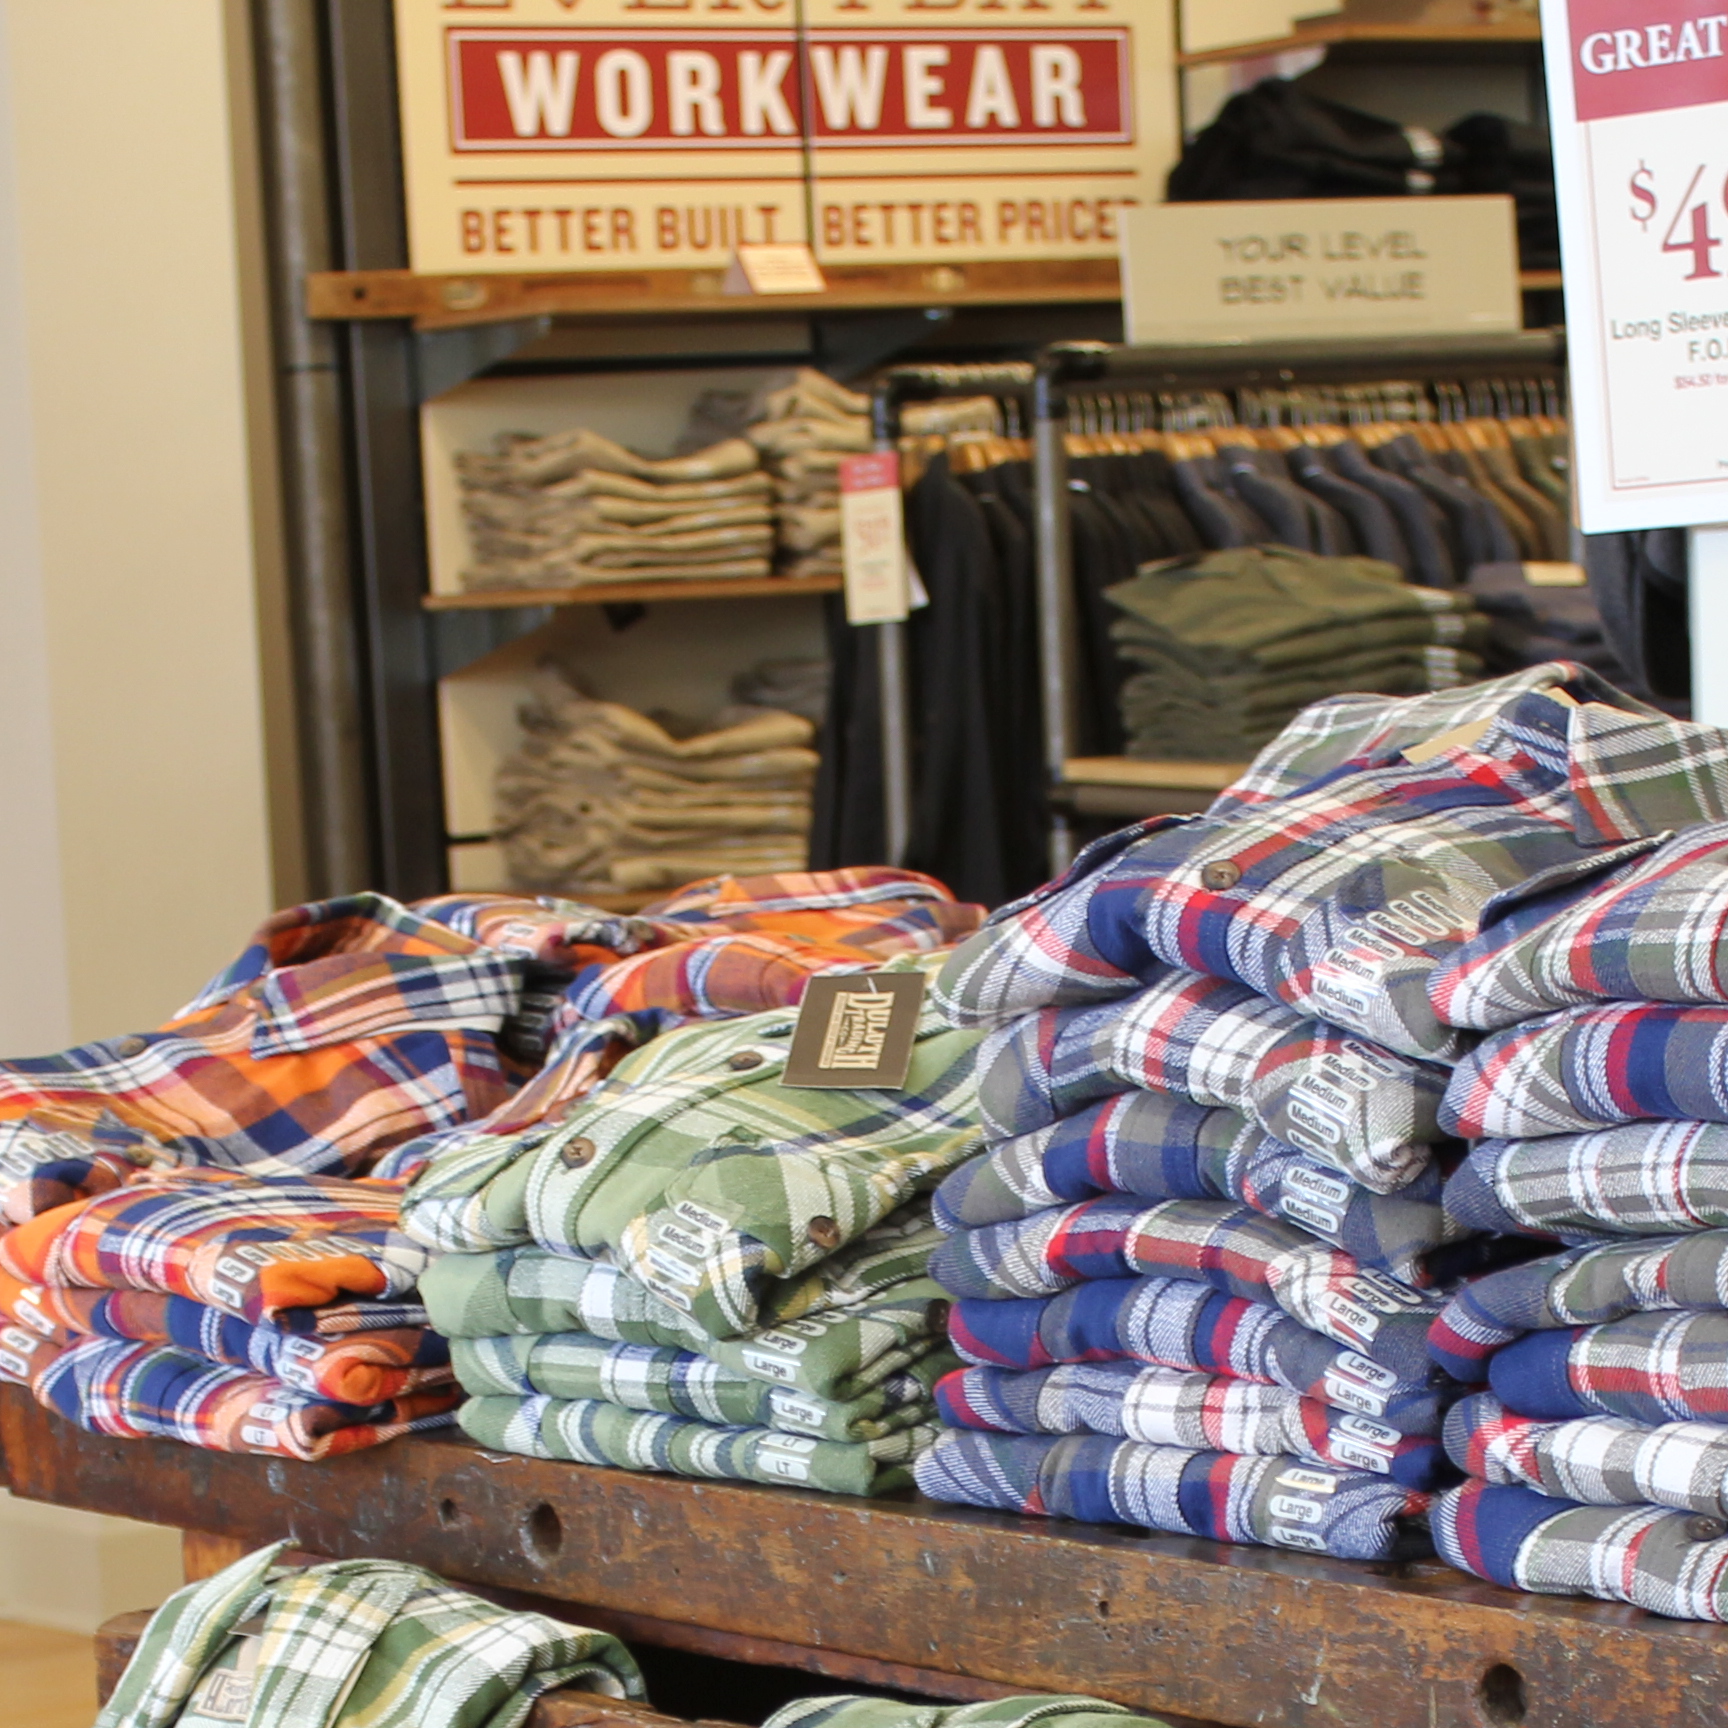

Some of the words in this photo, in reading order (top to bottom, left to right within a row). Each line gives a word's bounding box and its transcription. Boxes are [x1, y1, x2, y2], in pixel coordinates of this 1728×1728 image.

[1577, 14, 1728, 76] GREAT
[494, 44, 1088, 139] WORKWEAR
[460, 206, 639, 255] BETTER
[654, 204, 782, 252] BUILT
[823, 201, 990, 247] BETTER
[995, 197, 1138, 244] PRICE
[1216, 231, 1309, 265] YOUR
[1320, 230, 1429, 260] LEVEL
[1218, 274, 1307, 305] BEST
[1322, 271, 1427, 301] VALUE
[1610, 314, 1662, 342] Long
[1373, 912, 1421, 944] Medium
[1395, 900, 1443, 935] Medium
[1347, 929, 1397, 958] Medium
[1329, 950, 1375, 981] Medium
[1316, 981, 1365, 1012] Medium
[1321, 1055, 1370, 1088] Medium
[1300, 1075, 1348, 1111] Medium
[1291, 1103, 1335, 1141] Medium
[1290, 1169, 1342, 1200] Medium
[678, 1202, 723, 1232] Medium
[1285, 1199, 1332, 1230] Medium
[660, 1225, 706, 1255] Medium
[1350, 1281, 1390, 1308] Large
[1328, 1296, 1369, 1327] Large
[762, 1331, 798, 1350] Large
[753, 1356, 788, 1378] Large
[1347, 1355, 1387, 1381] Large
[1335, 1381, 1373, 1410] Large
[780, 1402, 814, 1422] Large
[1351, 1417, 1391, 1440] Large
[775, 1459, 791, 1476] LT
[1340, 1444, 1379, 1469] Large
[1278, 1497, 1314, 1520] Large
[1279, 1528, 1318, 1548] Large
